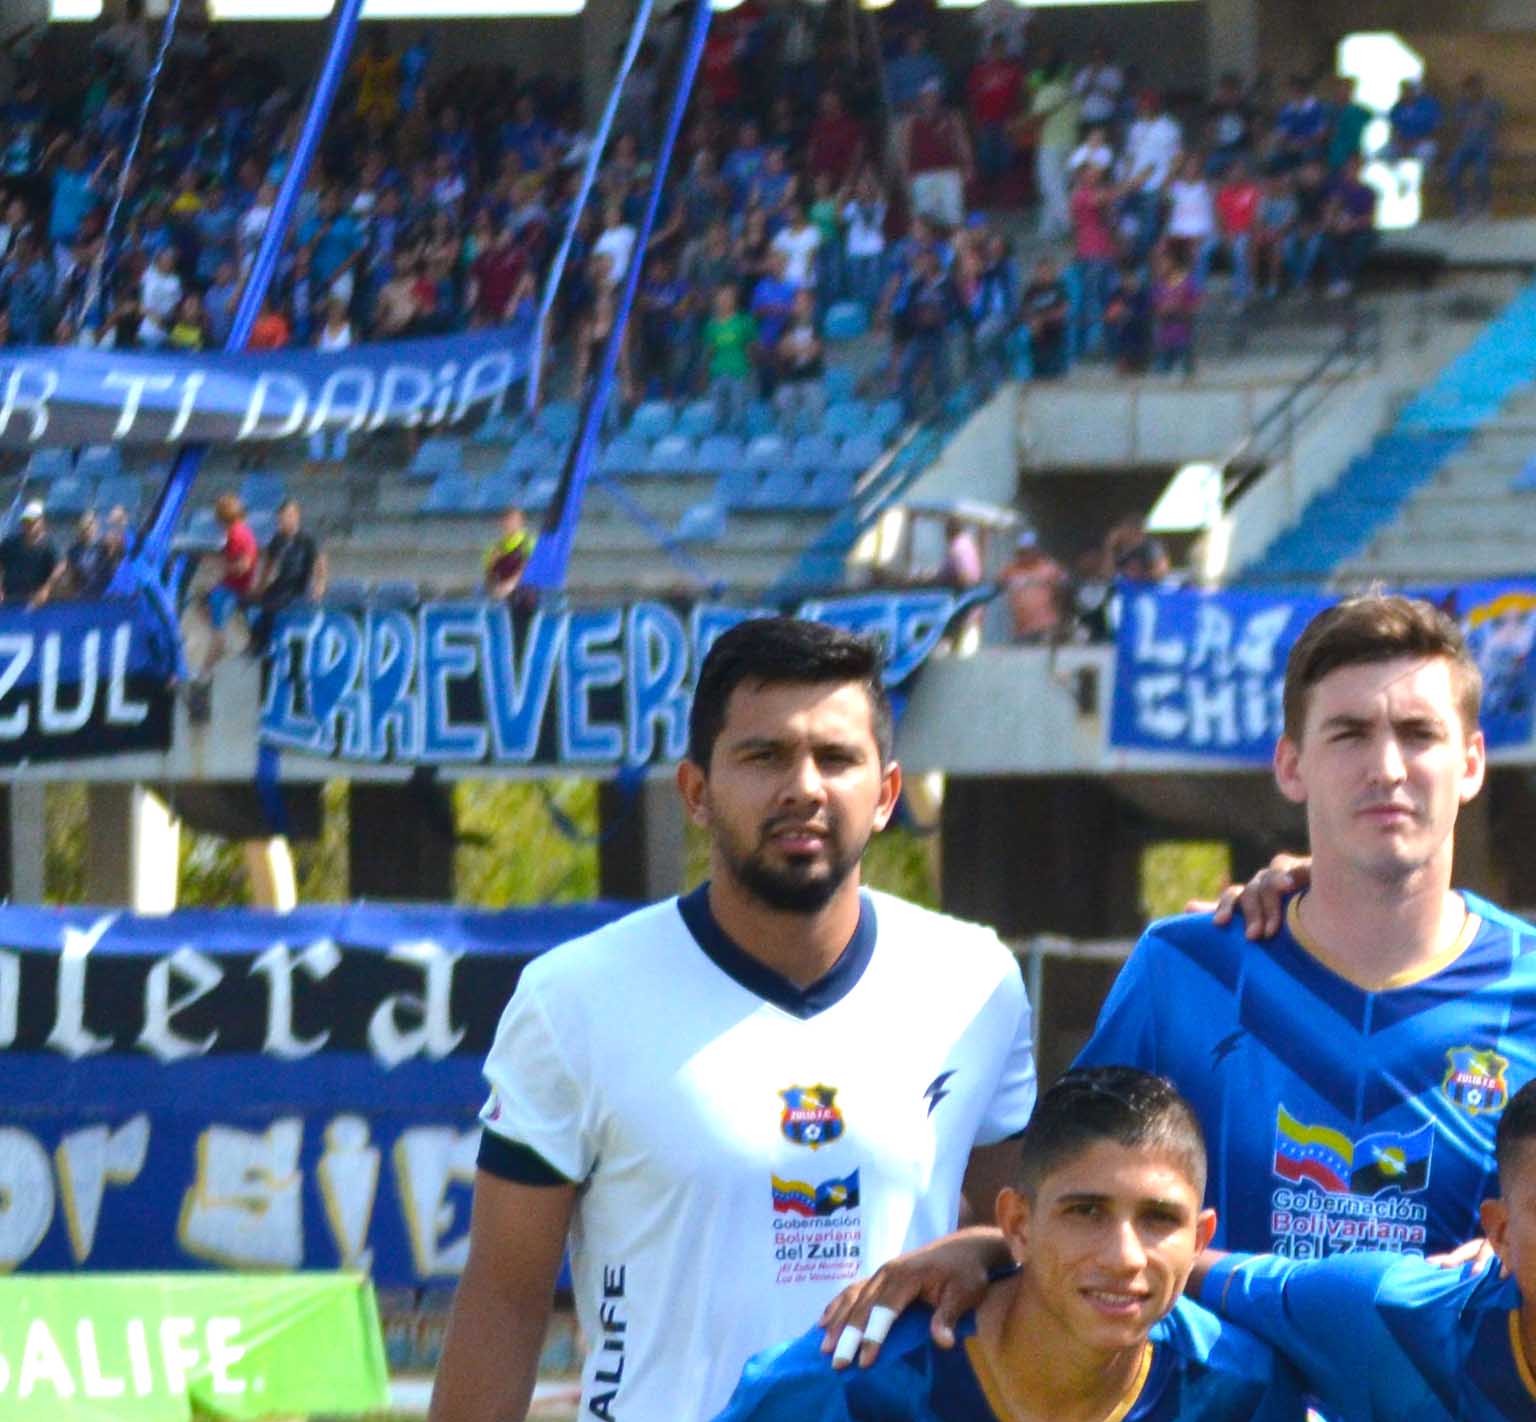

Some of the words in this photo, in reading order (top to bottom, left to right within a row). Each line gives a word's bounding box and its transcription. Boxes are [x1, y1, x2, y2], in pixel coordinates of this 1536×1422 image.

[104, 370, 207, 443] TI
[1131, 597, 1292, 674] LAS
[1272, 1187, 1428, 1221] Gobernación
[1271, 1210, 1426, 1244] Bolivariana
[775, 1244, 802, 1261] del
[807, 1242, 860, 1259] Zulia
